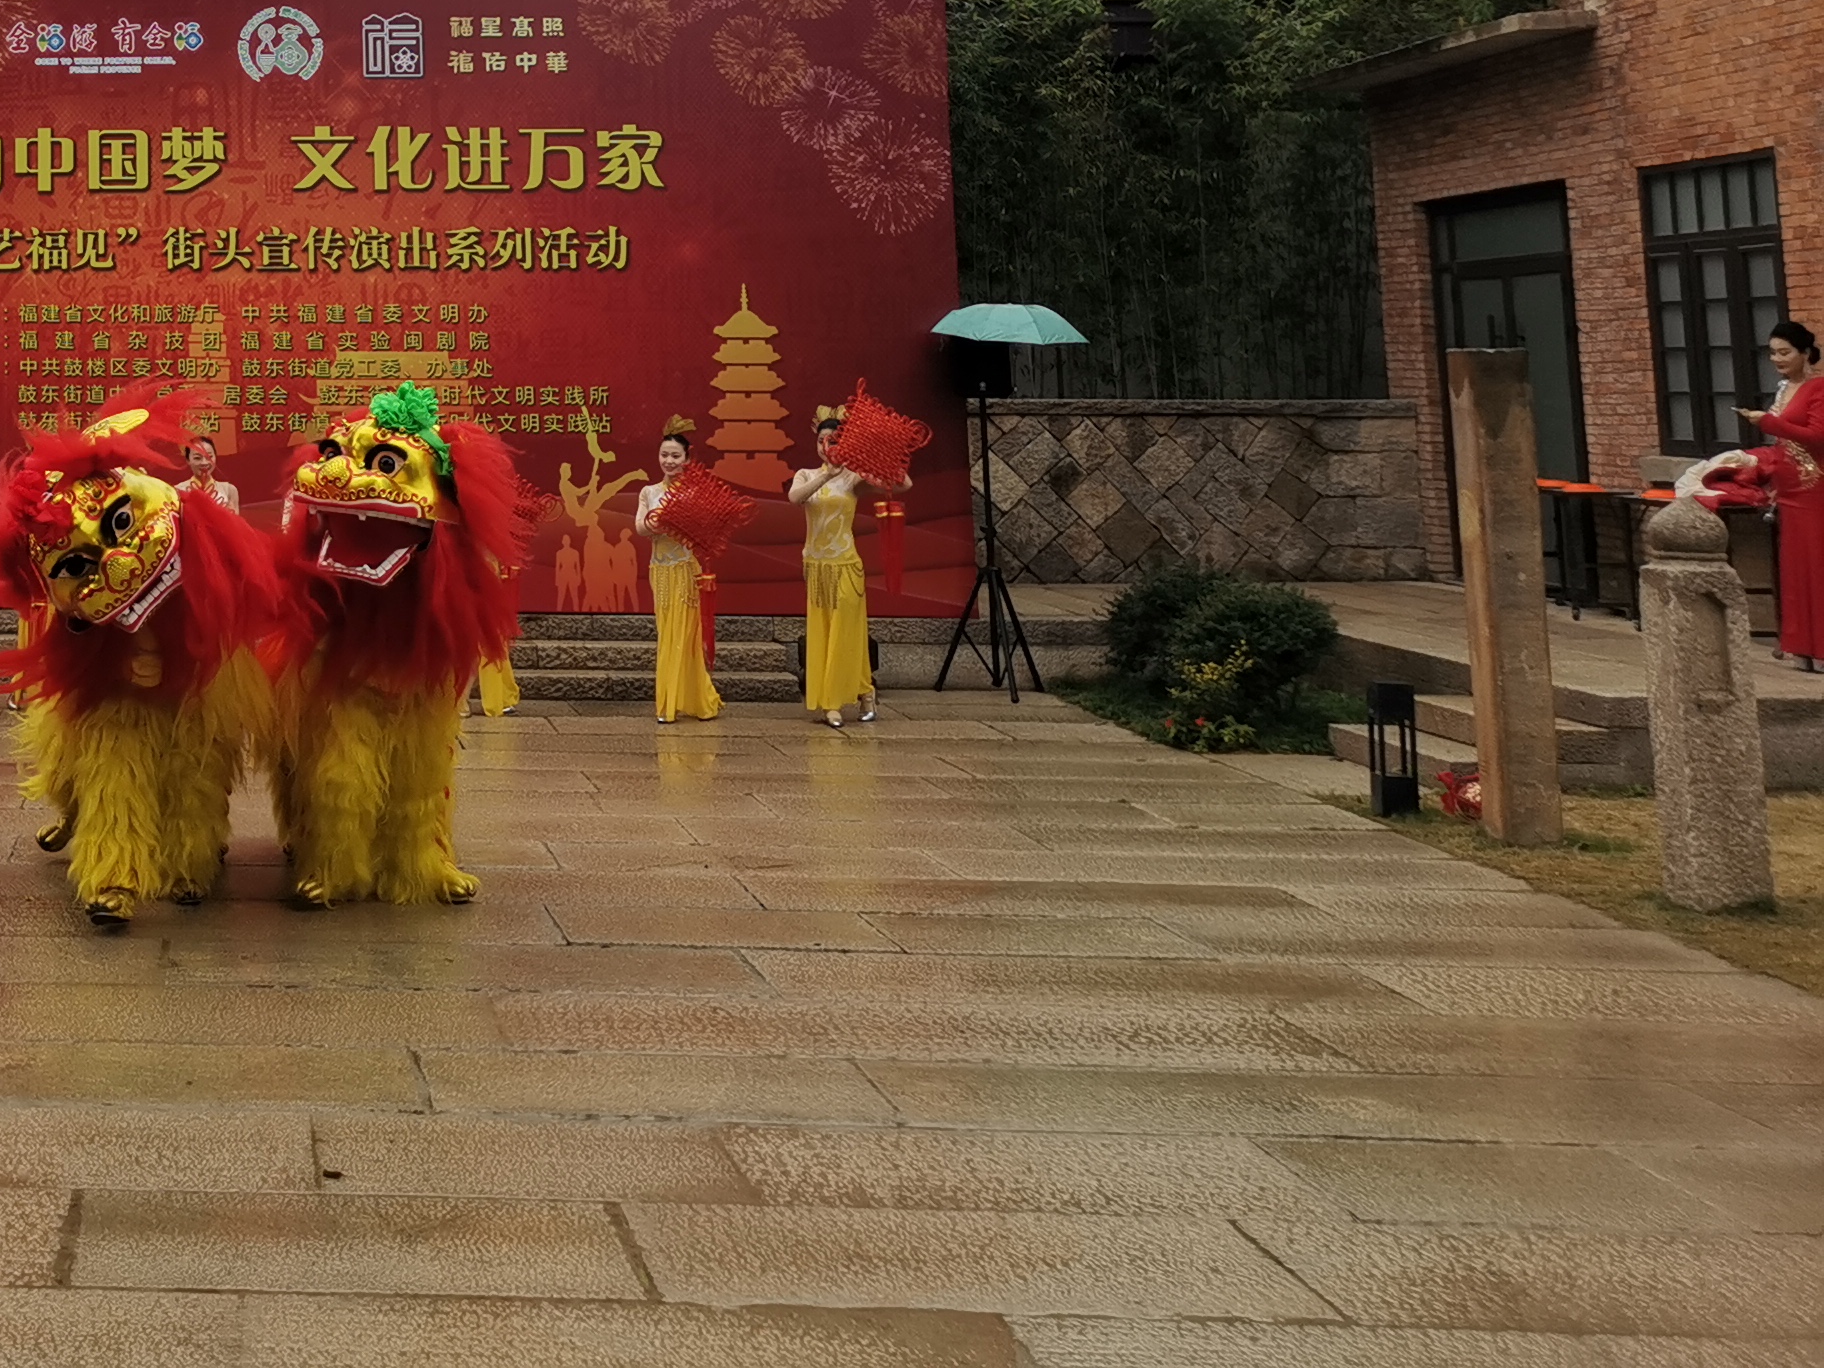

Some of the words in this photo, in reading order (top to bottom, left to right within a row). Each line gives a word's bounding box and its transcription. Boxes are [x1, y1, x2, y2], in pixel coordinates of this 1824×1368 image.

[290, 123, 666, 191] 文化进万家
[241, 303, 489, 324] 中共福建省委文明办
[240, 330, 491, 351] 福建省实验闽剧院
[241, 358, 494, 379] 鼓东街道党工委、办事处
